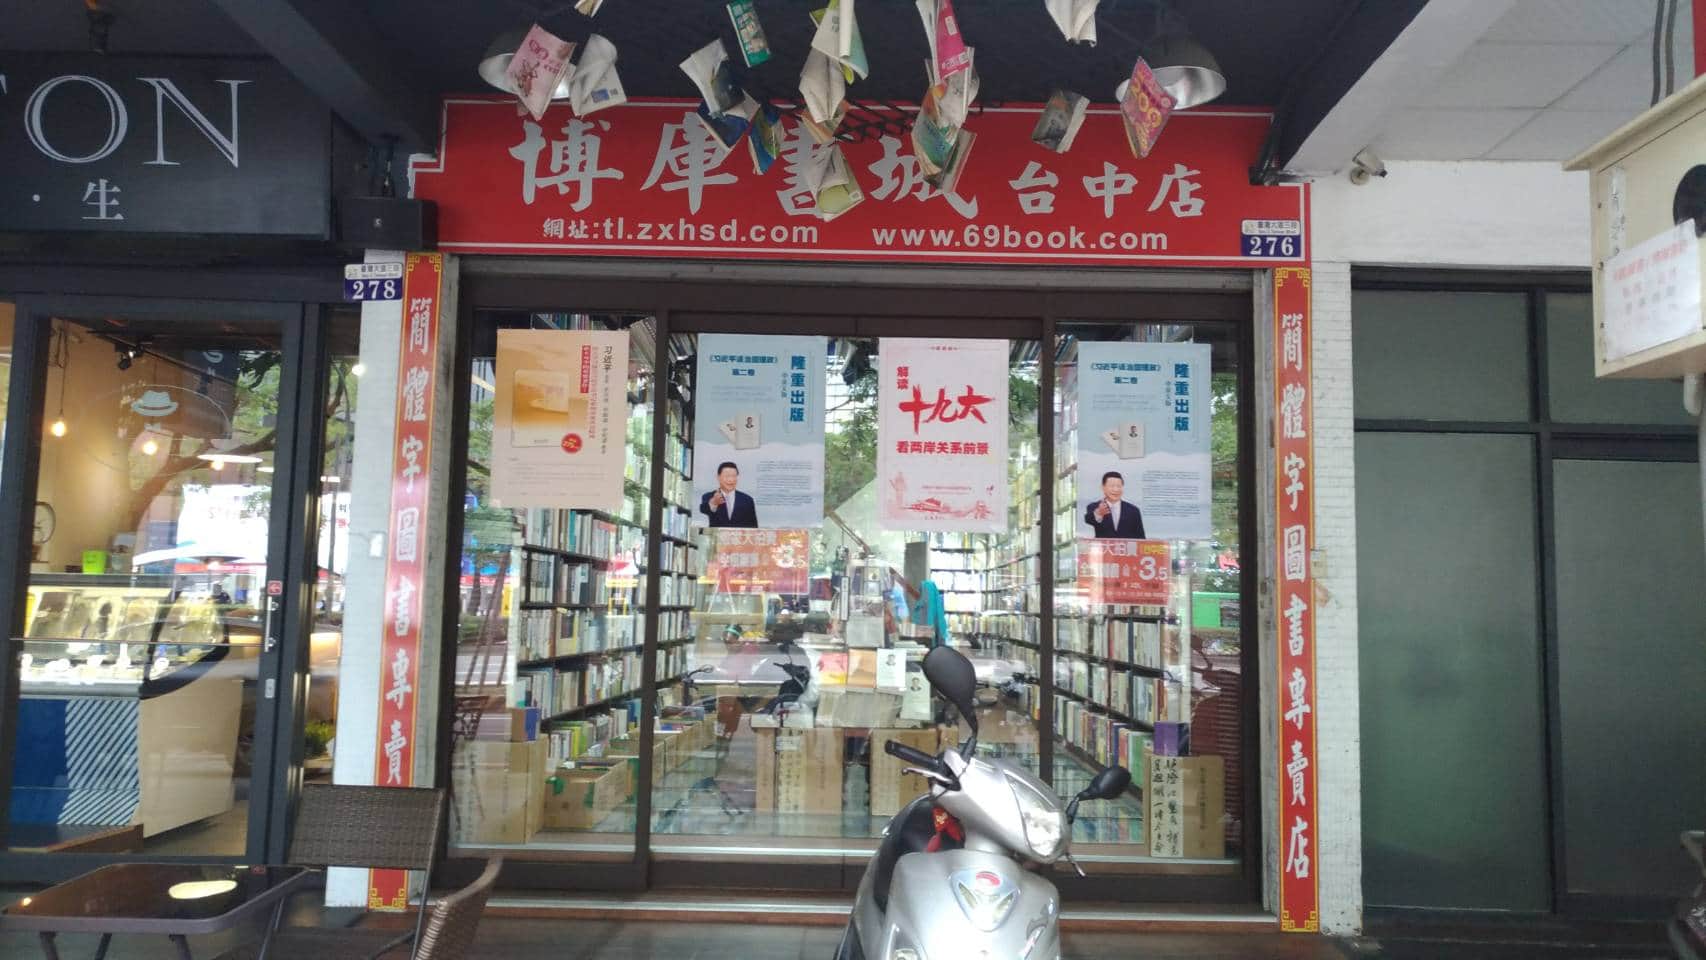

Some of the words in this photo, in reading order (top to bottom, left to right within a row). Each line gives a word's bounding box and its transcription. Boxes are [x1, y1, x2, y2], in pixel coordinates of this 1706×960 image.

[0, 75, 253, 168] ON
[81, 179, 125, 220] 生
[1008, 160, 1206, 219] 台中店
[872, 224, 1168, 250] www.69book.com
[1249, 236, 1294, 256] 276
[352, 280, 396, 300] 278
[790, 355, 806, 422] 隆重出版
[898, 384, 996, 435] 十九大
[1174, 363, 1189, 432] 隆重出版
[896, 441, 989, 455] 看两岸关系前景
